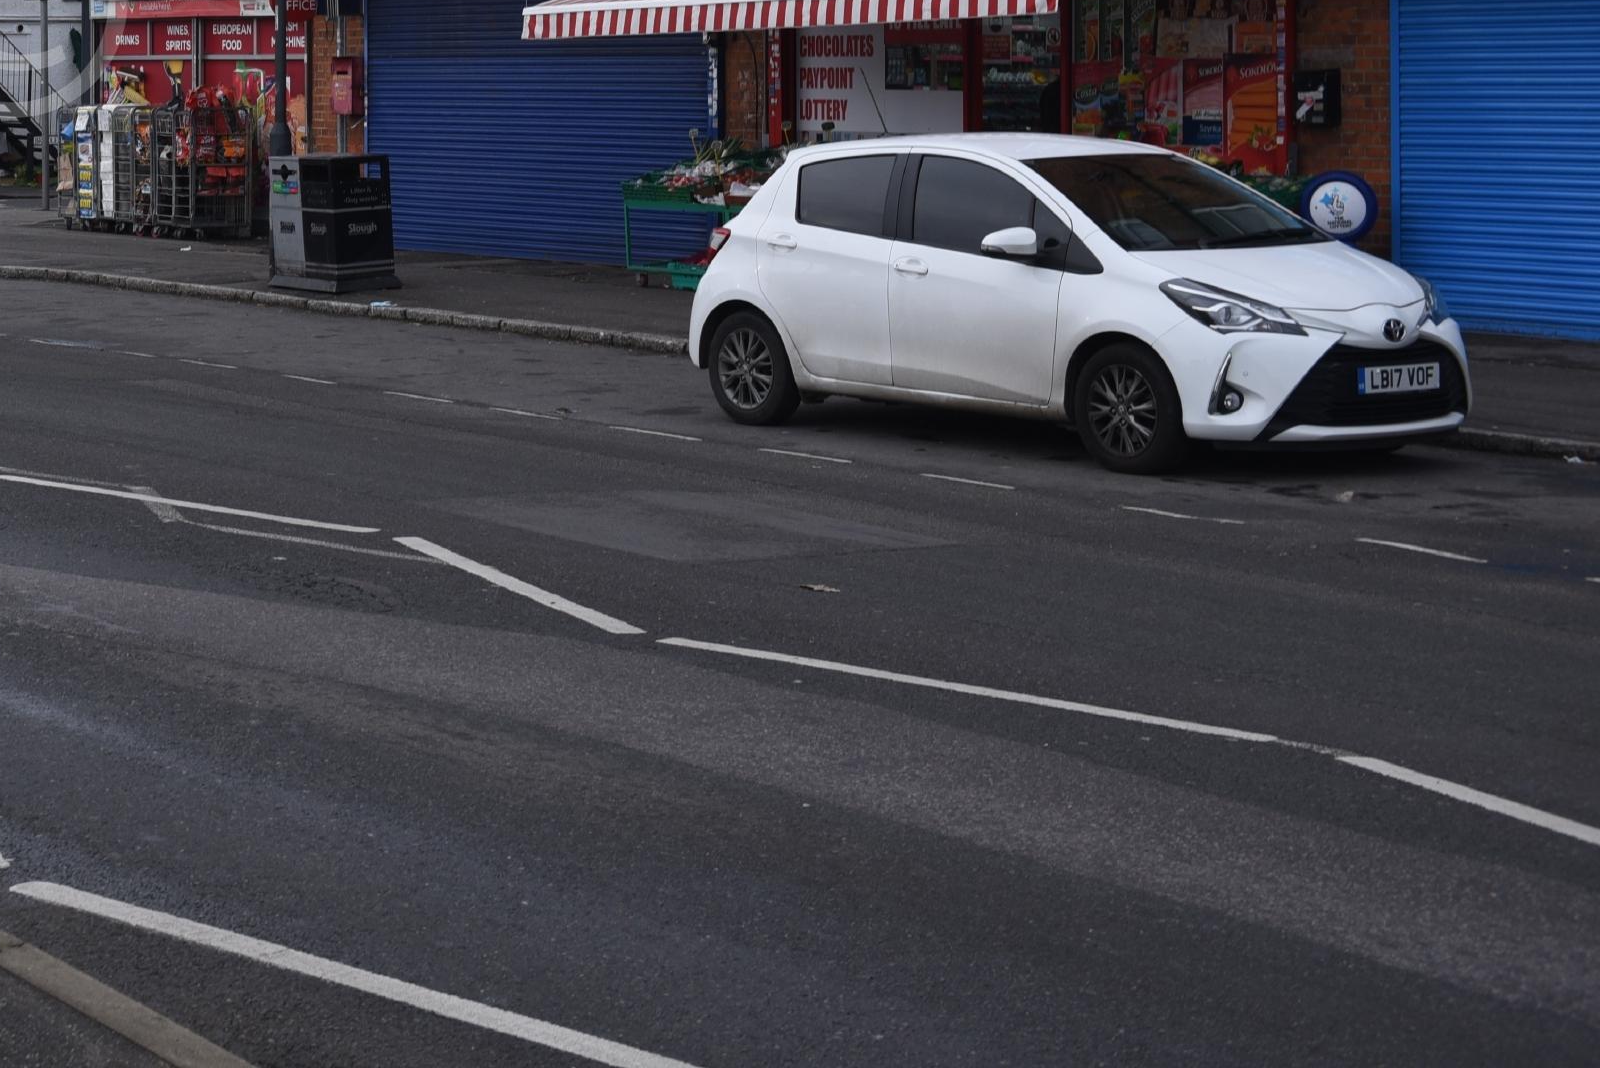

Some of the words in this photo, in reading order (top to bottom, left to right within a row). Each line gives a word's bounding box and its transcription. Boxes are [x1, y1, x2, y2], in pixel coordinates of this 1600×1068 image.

[286, 0, 317, 11] FFICE
[212, 23, 251, 35] EUROPEAN
[115, 35, 140, 46] DRINKS
[165, 39, 191, 52] SPIRITS
[221, 39, 242, 51] FOOD
[800, 34, 875, 57] CHOCOLATES
[800, 67, 855, 90] PAYPOINT
[799, 99, 848, 121] LOTTERY
[347, 221, 378, 234] Slough
[1370, 368, 1402, 390] LB17
[1407, 365, 1435, 387] VOF
